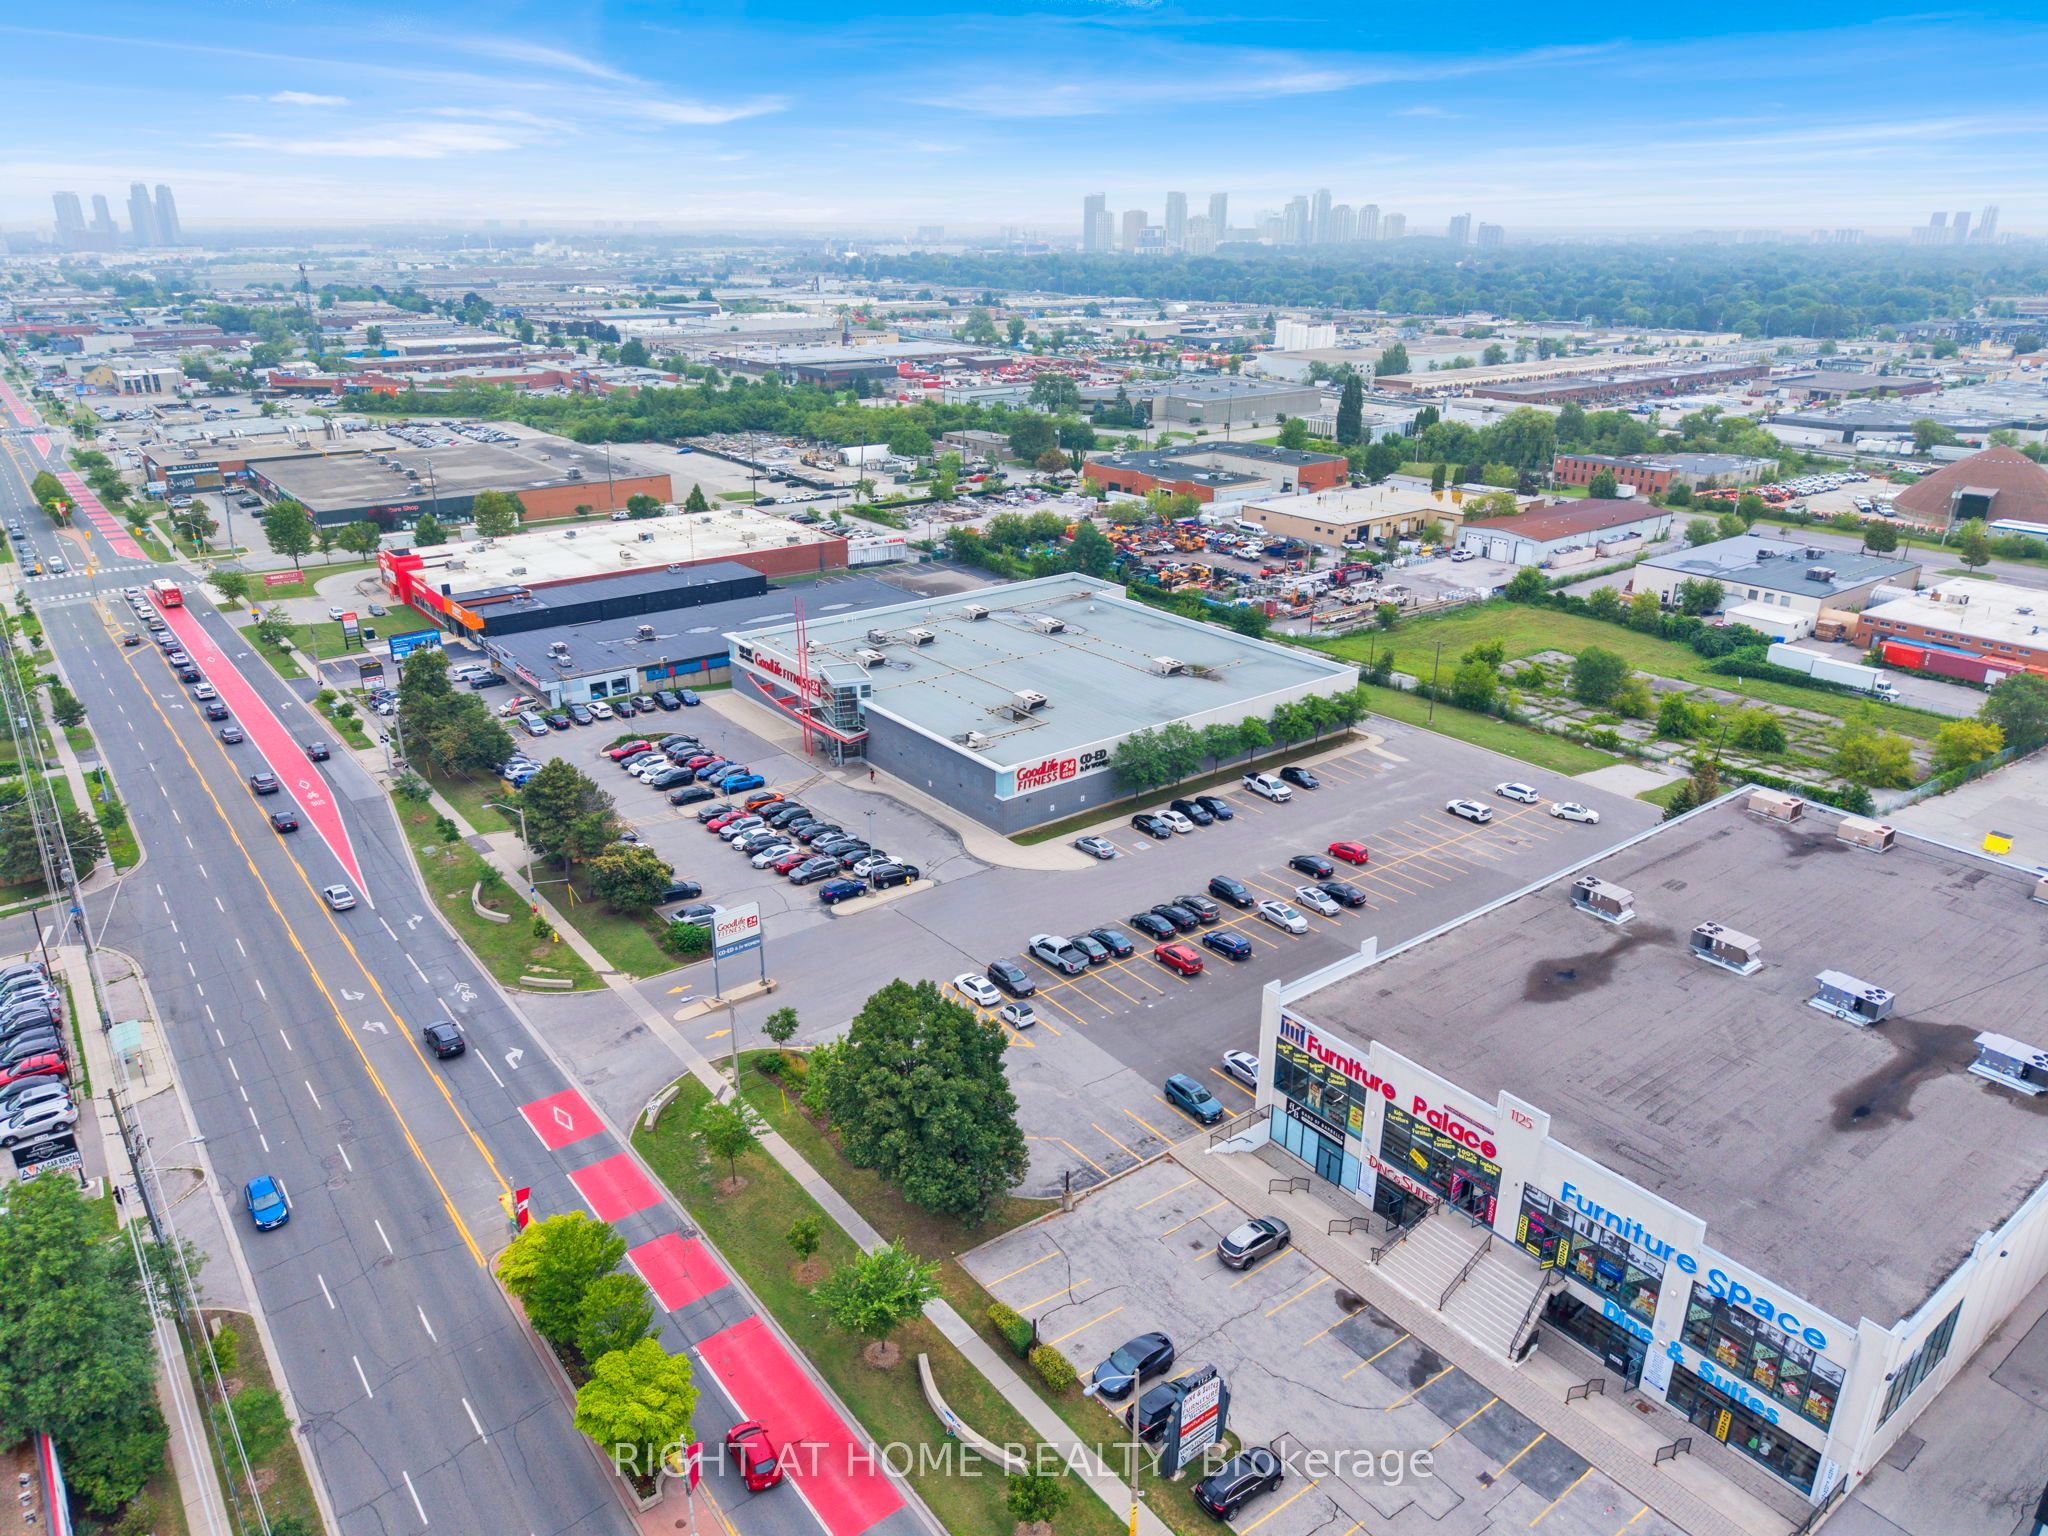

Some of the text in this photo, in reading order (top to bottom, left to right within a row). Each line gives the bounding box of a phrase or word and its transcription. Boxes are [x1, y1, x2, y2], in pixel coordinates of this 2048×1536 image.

[754, 652, 782, 677] GoodLife
[1017, 749, 1107, 781] GoodLife 24 CO-ED
[1017, 772, 1058, 792] FITNESS
[717, 916, 746, 932] GoodLife
[718, 925, 746, 938] FITNESS
[718, 947, 734, 957] CO-ED
[1307, 1035, 1396, 1100] Furniture
[1412, 1095, 1497, 1158] Palace
[1388, 1113, 1409, 1124] Furniture
[1511, 1109, 1533, 1129] 1125
[1412, 1128, 1433, 1138] Furniture
[1433, 1141, 1455, 1150] Furniture
[1457, 1147, 1478, 1160] 100%
[46, 1160, 58, 1168] CAR
[59, 1154, 80, 1165] RENTAL
[1561, 1181, 1827, 1350] Furniture Space
[1602, 1298, 1654, 1344] Dine
[1666, 1341, 1686, 1364] &
[1697, 1360, 1780, 1425] Suites
[1183, 1389, 1219, 1416] FURNITURE
